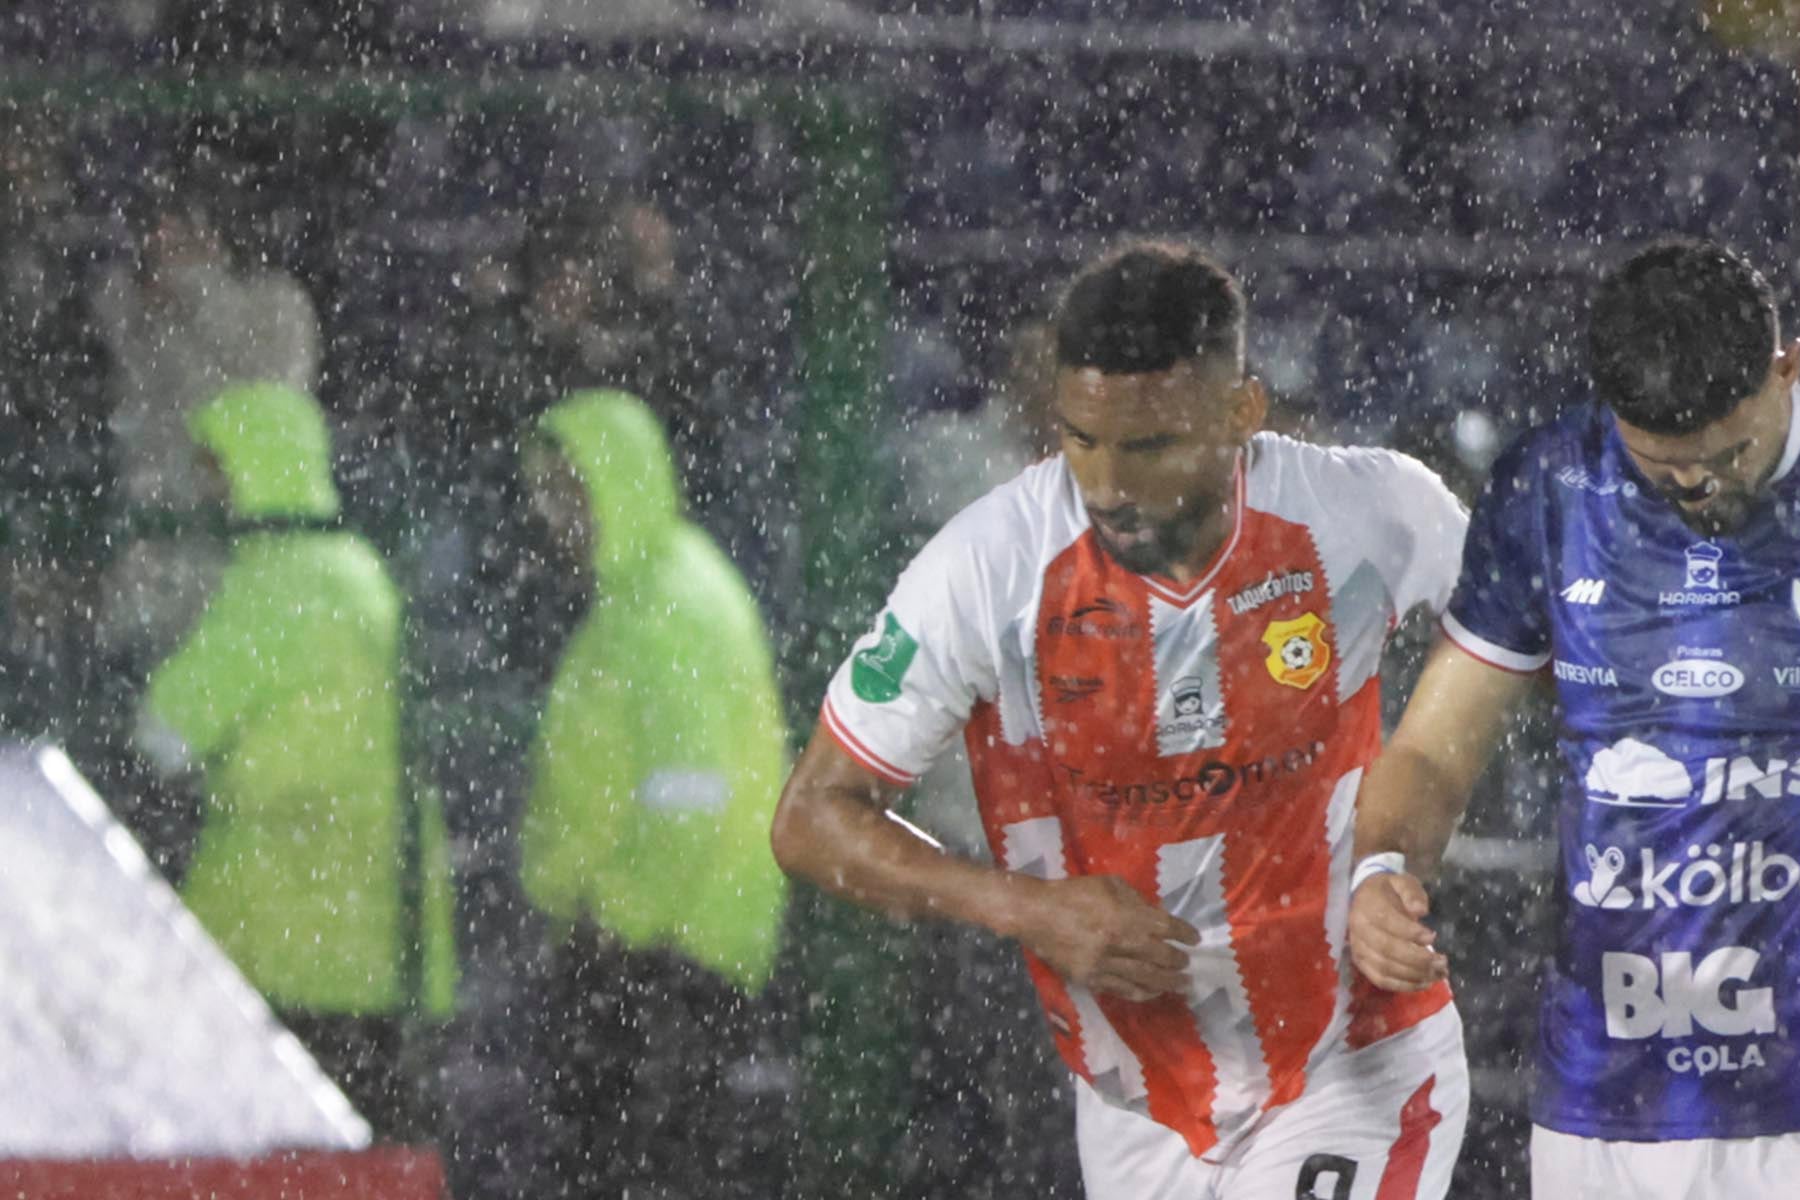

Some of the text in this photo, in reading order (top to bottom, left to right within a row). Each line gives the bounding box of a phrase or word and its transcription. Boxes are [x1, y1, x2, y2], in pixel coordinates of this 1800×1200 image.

[1659, 592, 1741, 606] HARIANA
[1659, 670, 1735, 688] CELCO
[1602, 946, 1775, 1039] BIG
[1667, 1043, 1765, 1073] COLA
